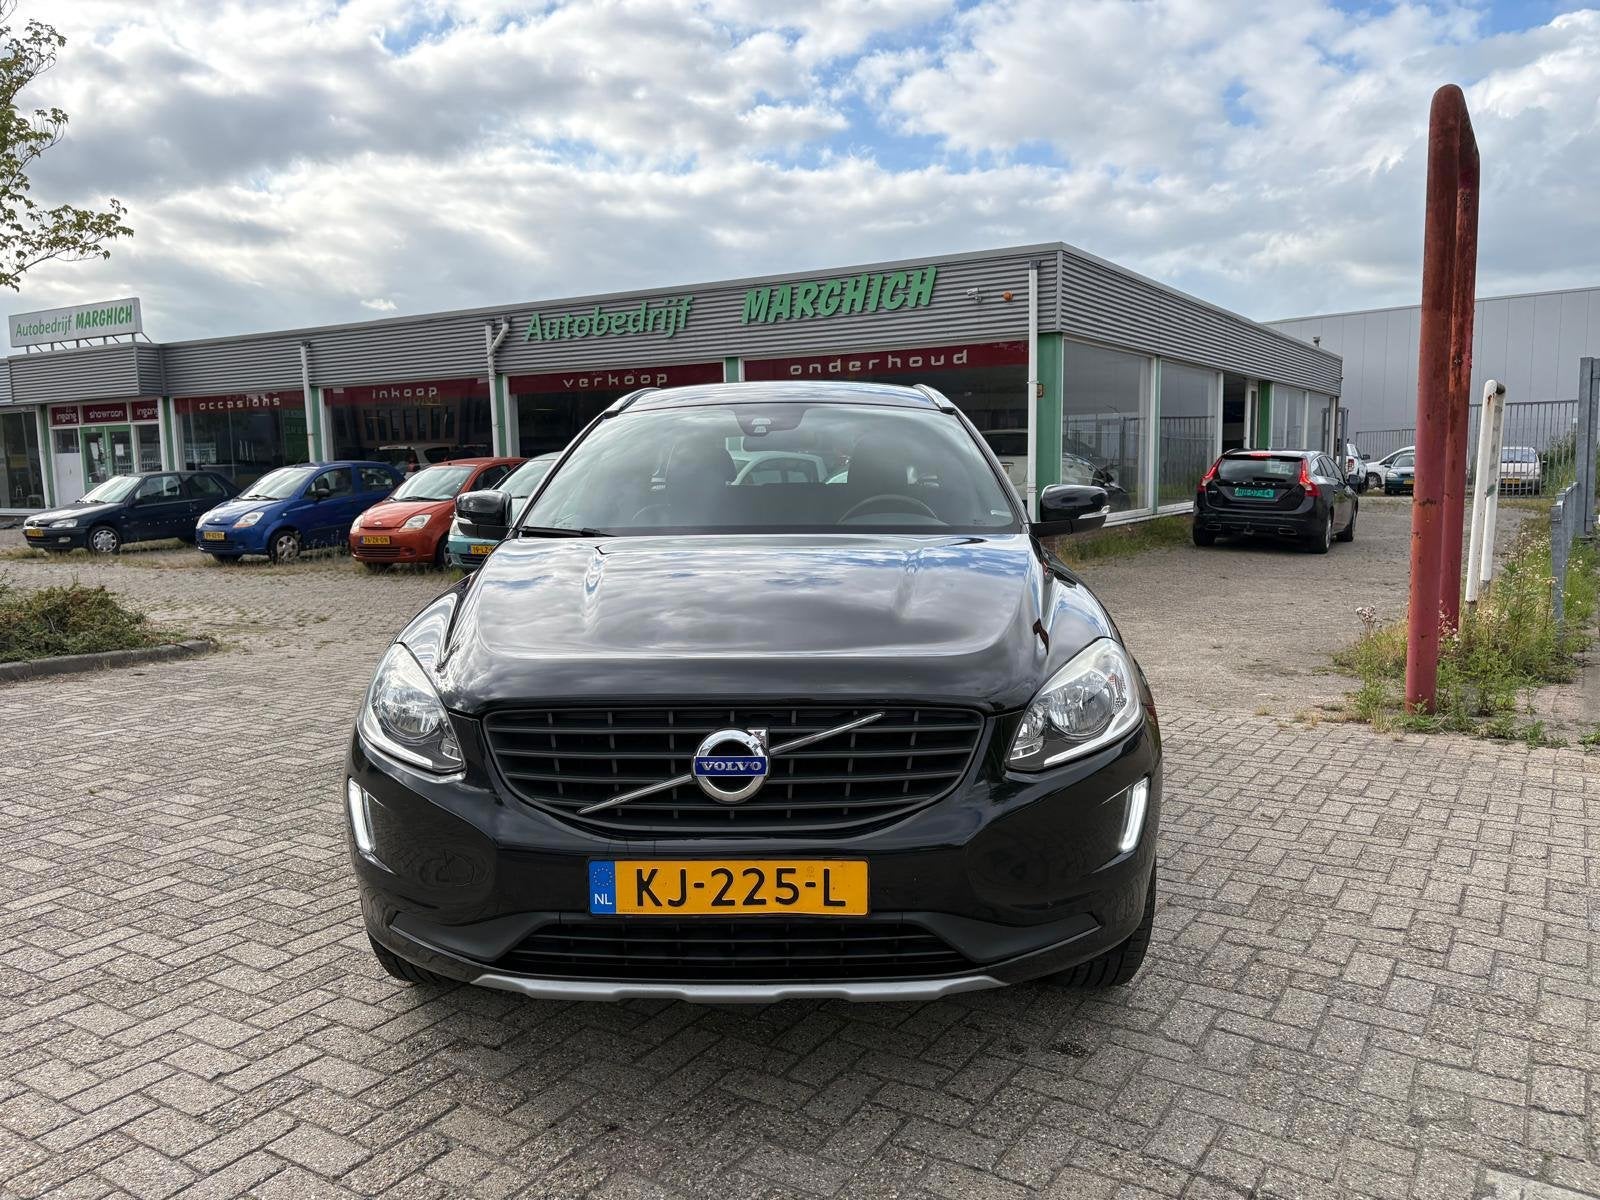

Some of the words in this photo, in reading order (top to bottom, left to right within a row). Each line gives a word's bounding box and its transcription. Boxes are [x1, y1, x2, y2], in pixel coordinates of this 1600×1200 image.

[525, 295, 692, 342] Autobedrijf
[741, 266, 937, 324] MARGHICH
[15, 315, 72, 336] Autobedrijf
[75, 304, 133, 330] MARGHICH
[790, 349, 968, 375] onderhoud
[563, 372, 668, 388] verkoop
[372, 386, 438, 399] inkoop
[199, 397, 281, 411] occasions
[701, 760, 762, 771] VOLVO
[636, 867, 847, 908] KJ-225-L
[594, 893, 613, 906] NL
